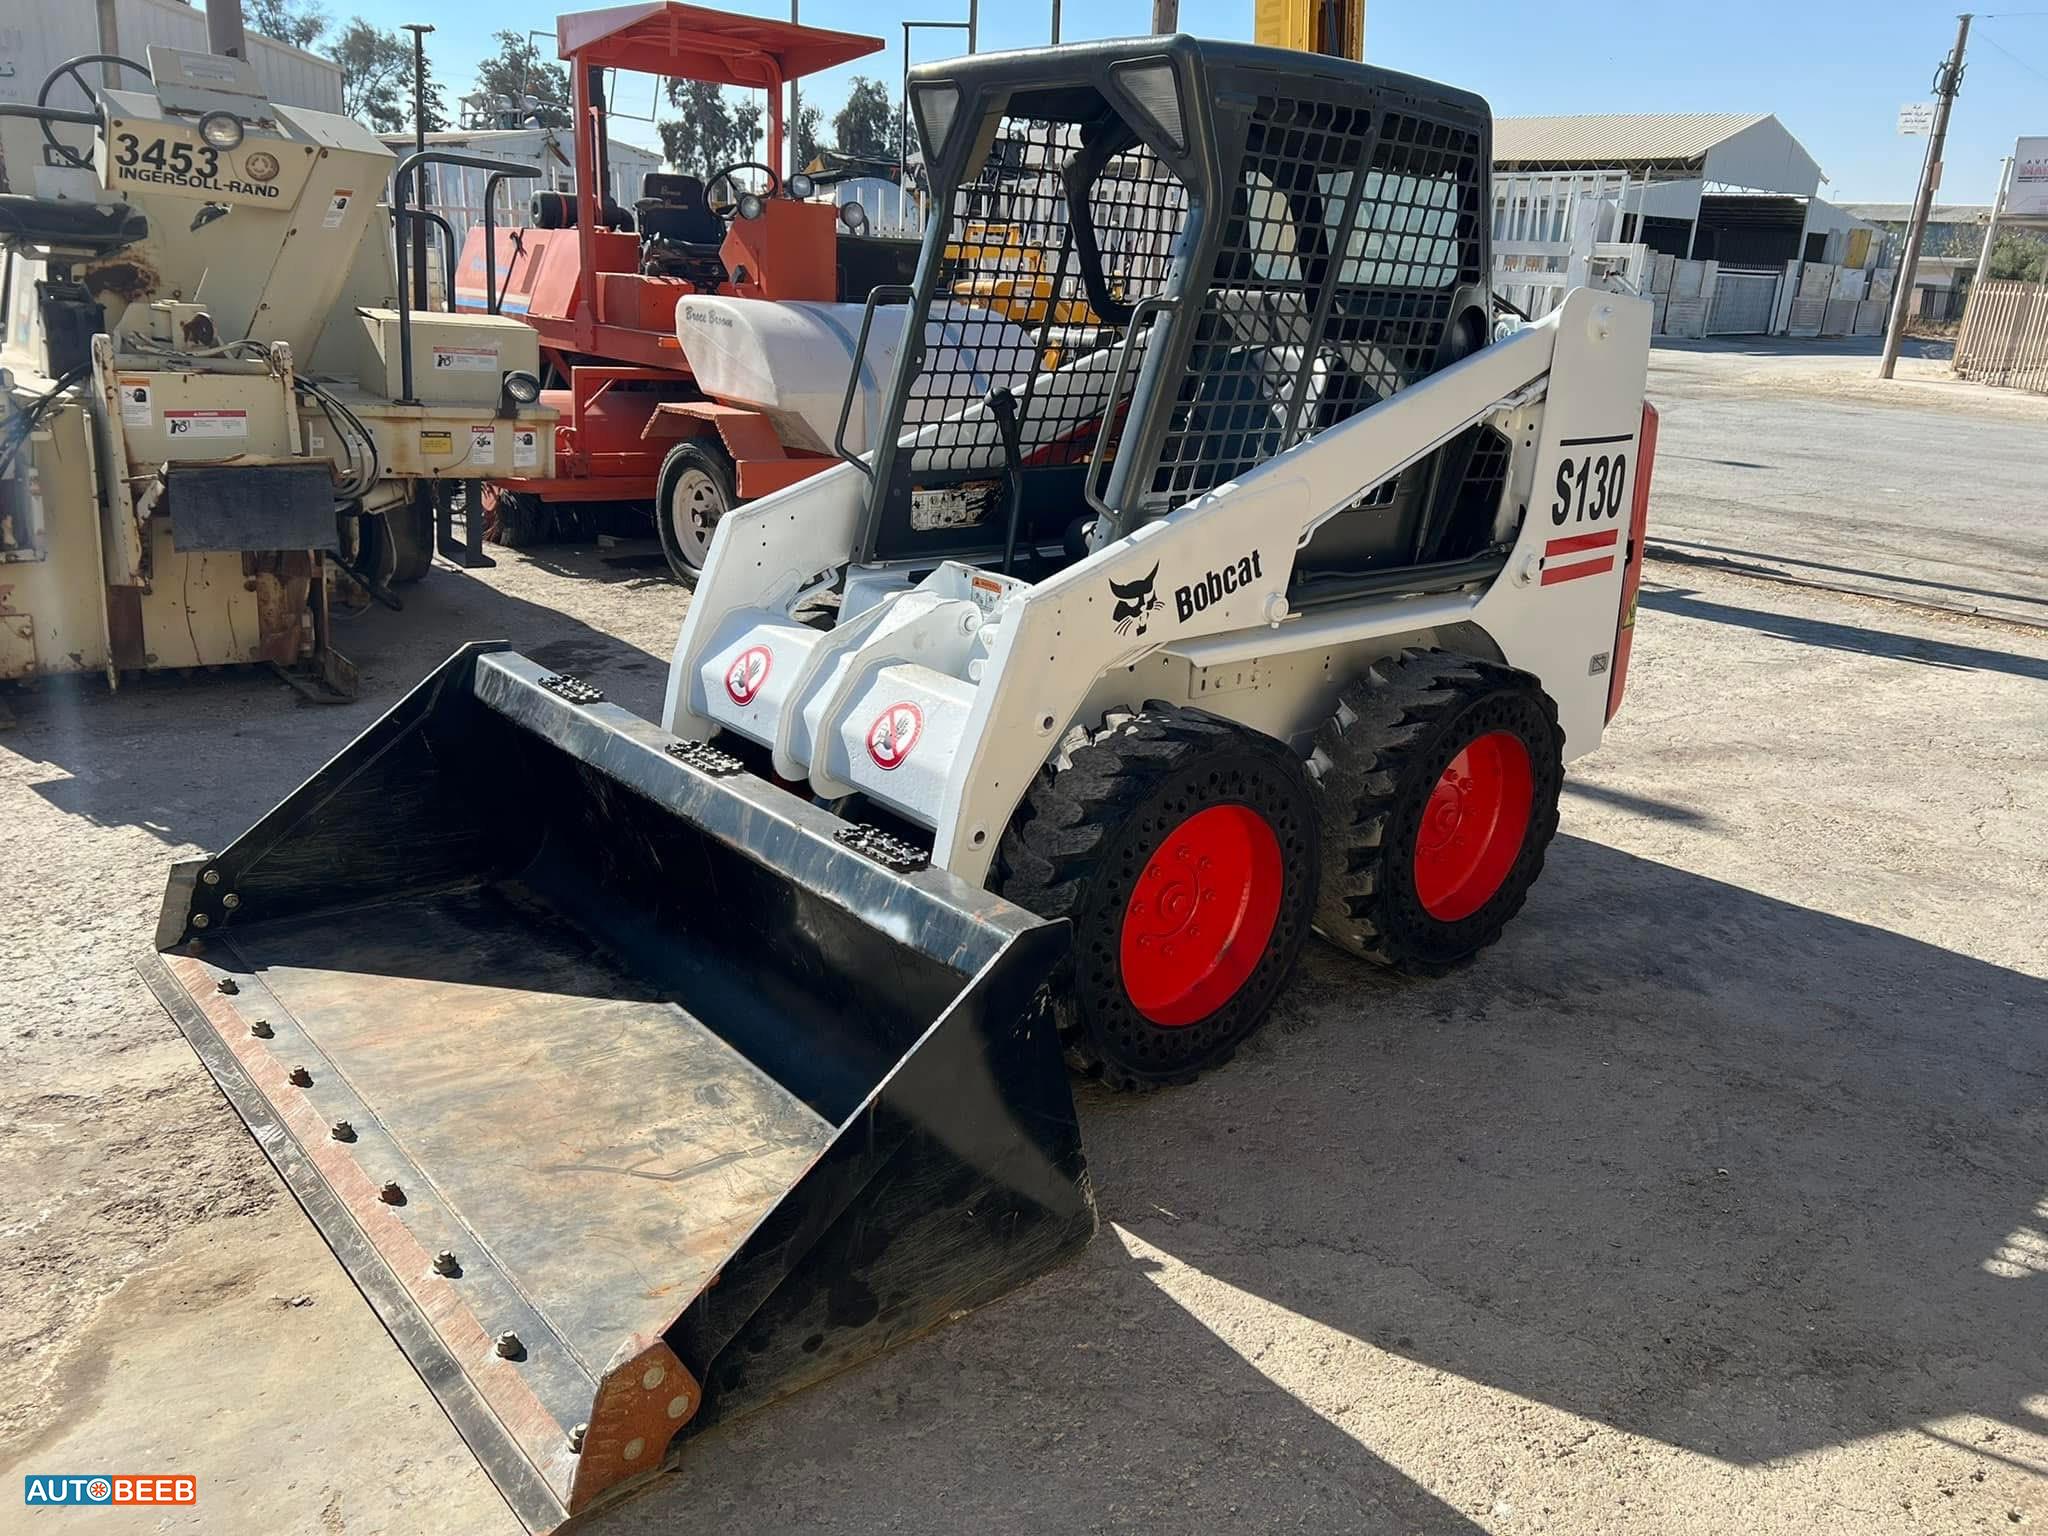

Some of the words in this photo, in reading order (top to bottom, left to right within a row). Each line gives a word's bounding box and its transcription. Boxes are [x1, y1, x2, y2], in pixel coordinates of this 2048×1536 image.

[115, 133, 218, 179] 3453
[119, 166, 280, 198] INGERSOLL-RAND
[1551, 453, 1626, 526] S130
[1174, 549, 1263, 624] Bobcat
